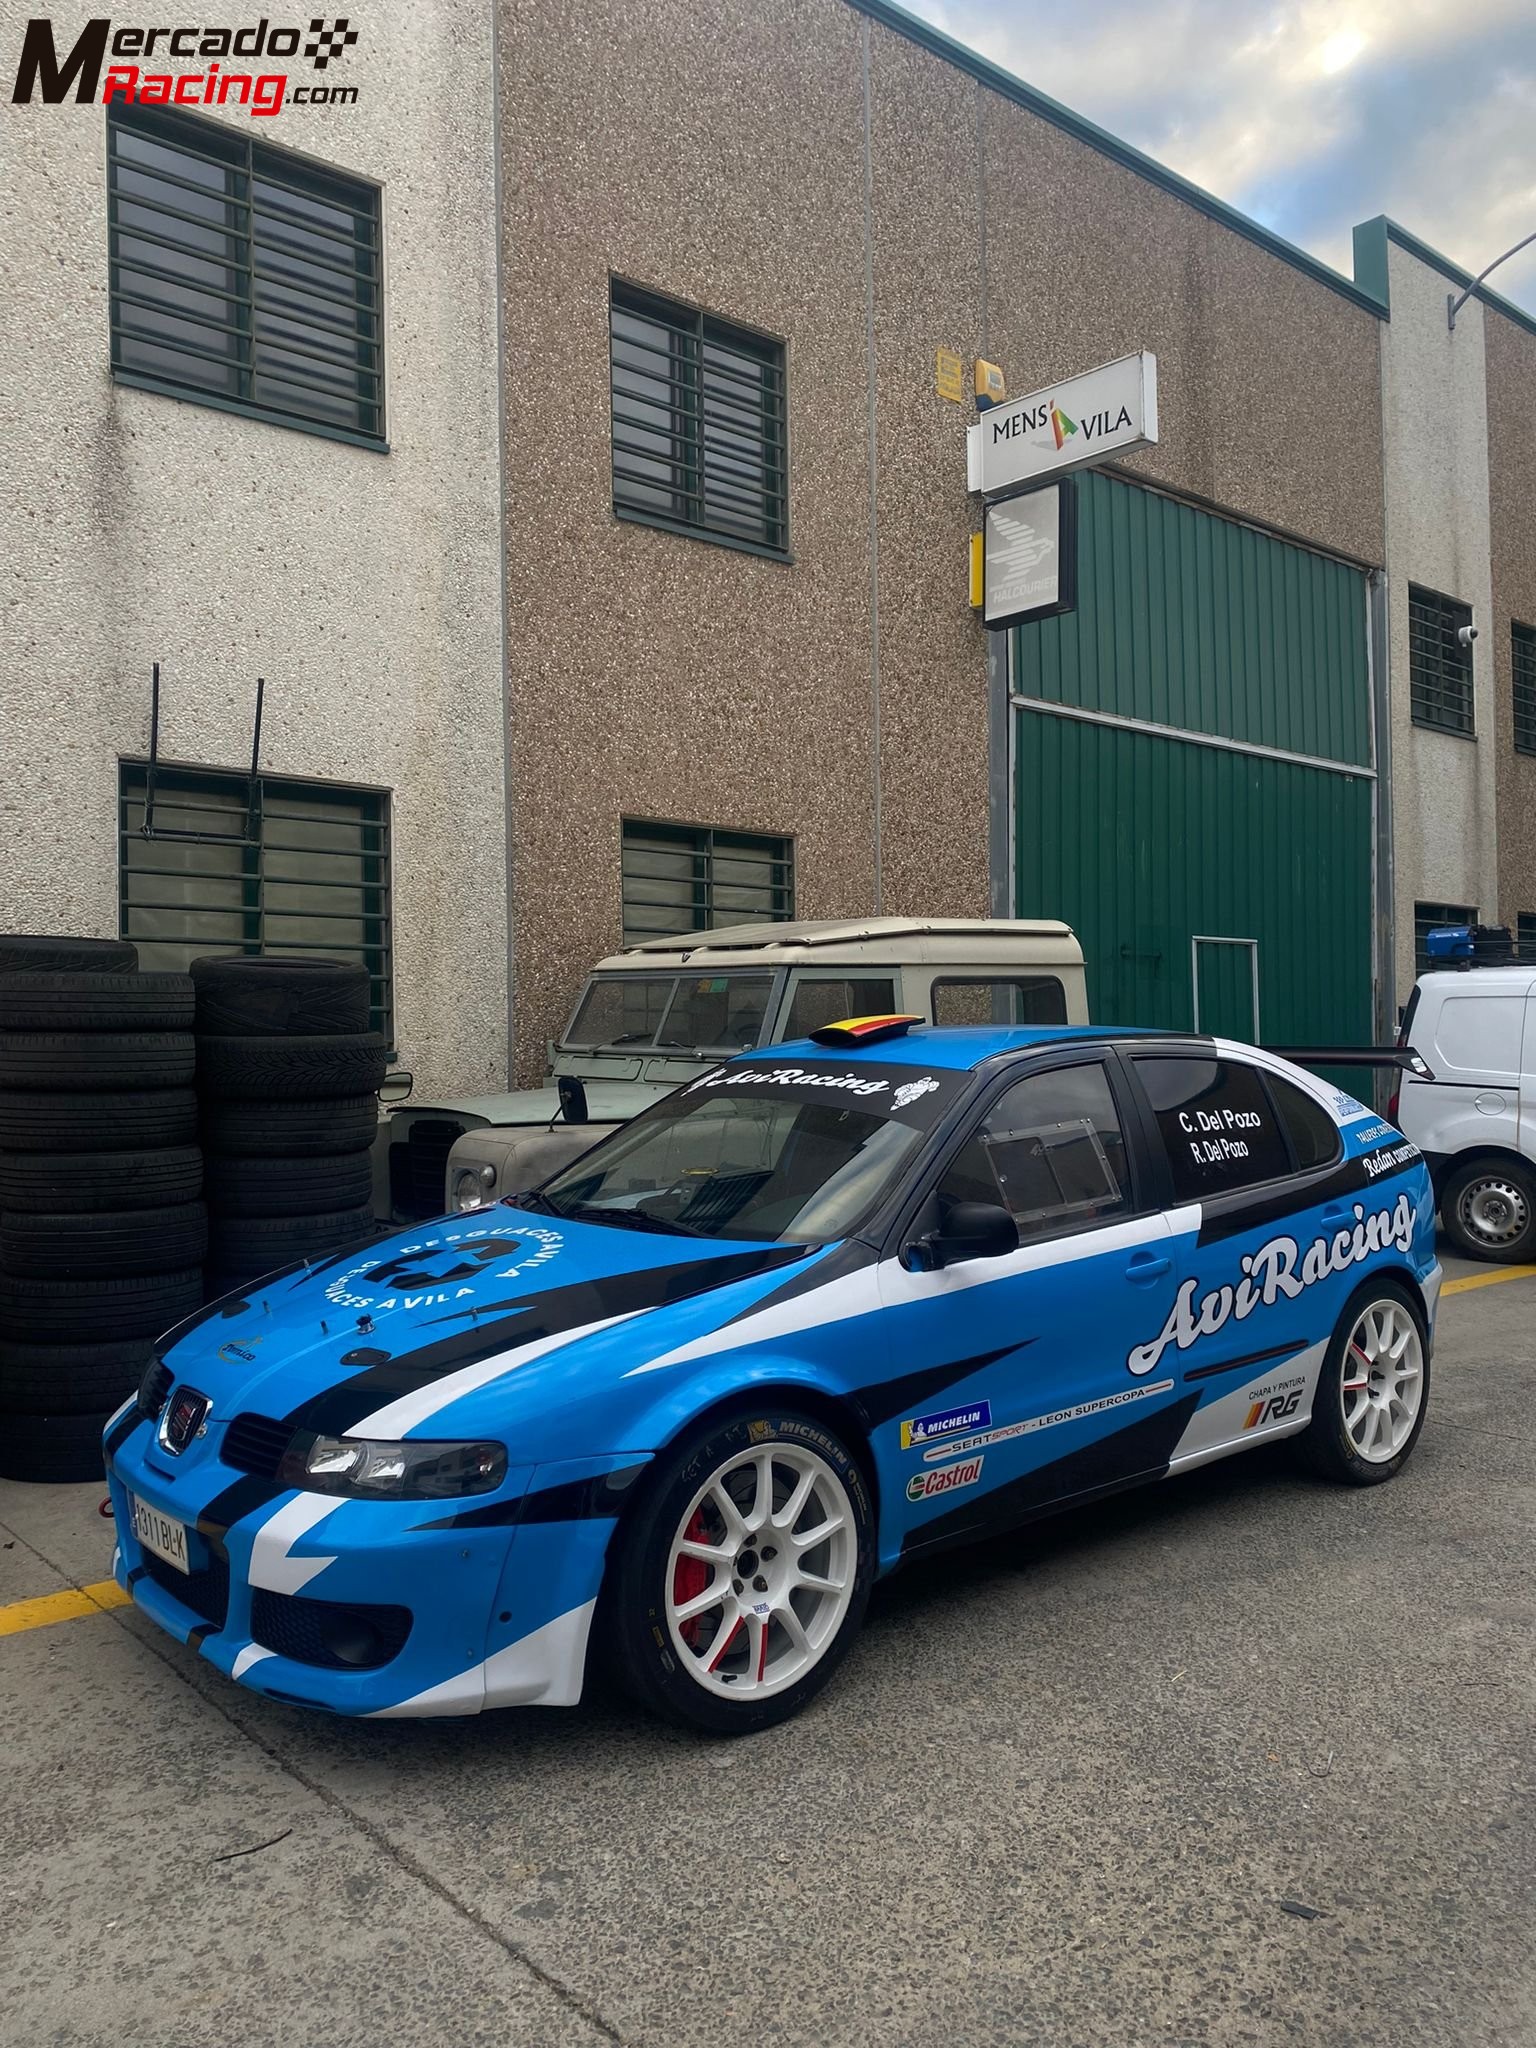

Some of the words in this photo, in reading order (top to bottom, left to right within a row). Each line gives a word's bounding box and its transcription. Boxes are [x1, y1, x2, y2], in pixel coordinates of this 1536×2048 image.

[706, 1069, 889, 1095] AviRacing
[1179, 1112, 1198, 1133] C.
[1196, 1110, 1224, 1131] Del
[1222, 1109, 1261, 1129] Pozo
[1189, 1142, 1207, 1164] R.
[1202, 1139, 1224, 1162] Del
[1220, 1138, 1249, 1159] Pozo
[495, 1243, 564, 1278] AVILA
[1127, 1193, 1417, 1376] AviRacing
[375, 1287, 476, 1309] AVILA
[1249, 1386, 1272, 1400] CHAPA
[1272, 1384, 1279, 1393] Y
[1278, 1376, 1306, 1391] PINTURA
[1039, 1410, 1072, 1427] LEON
[1075, 1388, 1146, 1416] SUPERCOPA
[927, 1411, 981, 1434] MICHELIN
[779, 1421, 847, 1464] MICHELIN
[925, 1460, 981, 1495] Castrol
